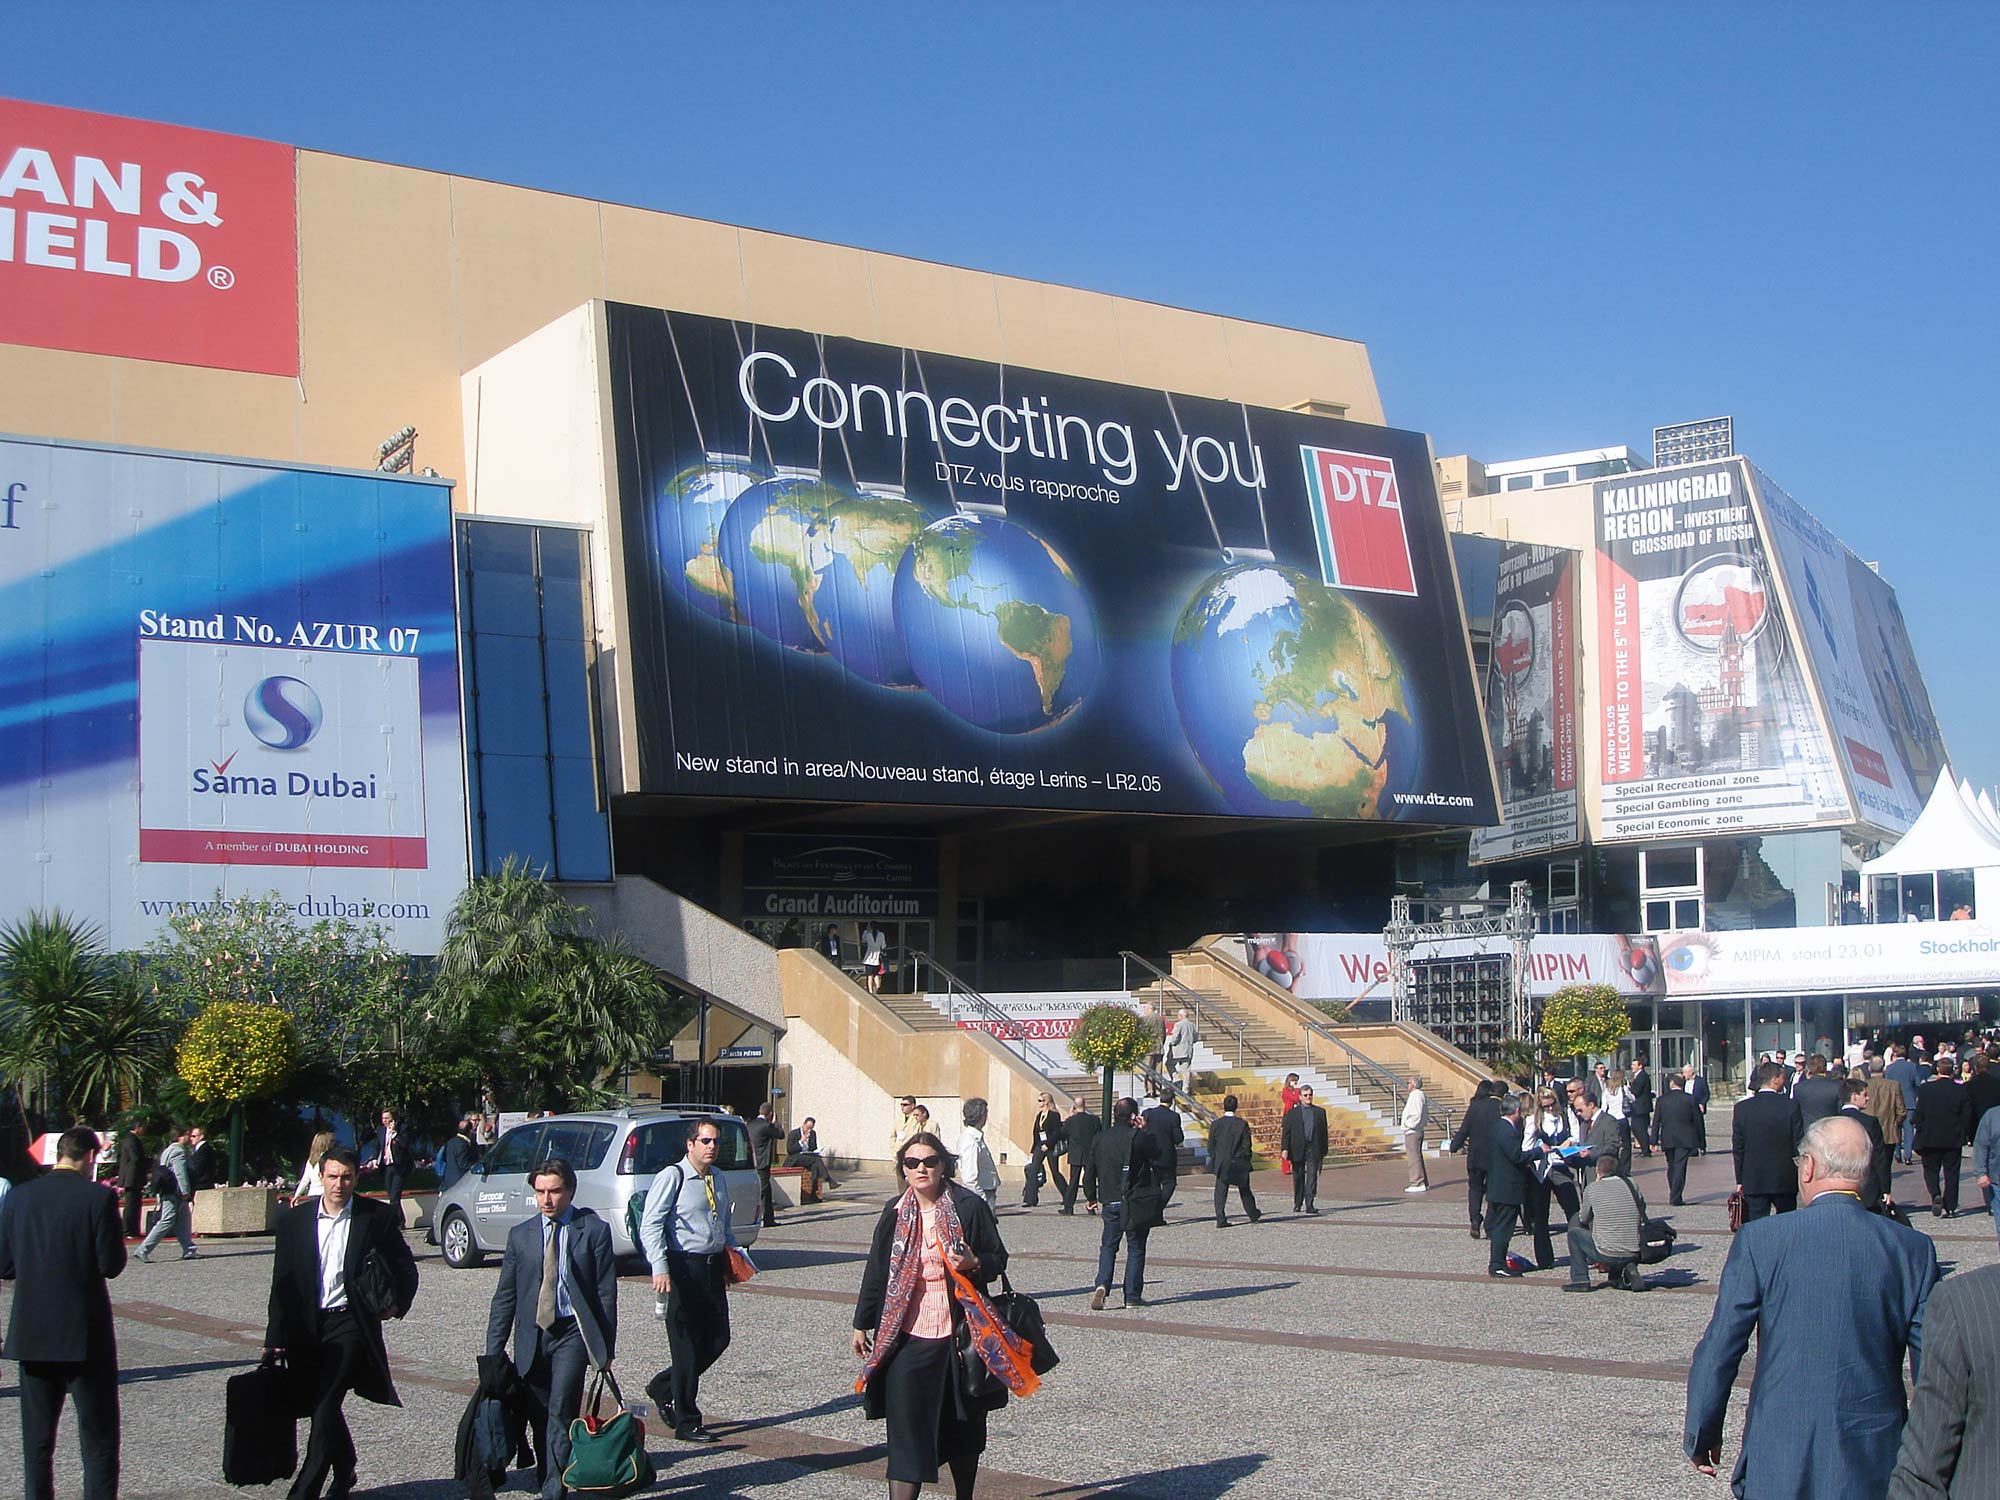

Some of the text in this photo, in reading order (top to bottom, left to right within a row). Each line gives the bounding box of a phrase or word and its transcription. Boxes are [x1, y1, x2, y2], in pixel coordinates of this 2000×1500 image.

[160, 171, 224, 227] &
[738, 351, 1267, 491] Connecting you
[935, 461, 1120, 504] DTZ vous rapproche
[1327, 462, 1399, 510] DTZ
[1602, 471, 1732, 515] KALININGRAD
[1604, 507, 1674, 542] REGION
[1684, 505, 1748, 529] INVESTMENT
[1632, 523, 1755, 556] CROSSROAD OF RUSSIA
[1614, 583, 1627, 626] LEVEL
[139, 609, 420, 653] Stand No. AZUR 07
[1616, 649, 1628, 678] THE
[1617, 681, 1630, 700] TO
[1606, 705, 1616, 775] STAND M5.05
[1617, 703, 1631, 774] WELCOME
[193, 768, 376, 799] Sama Dubai
[675, 752, 719, 773] New
[725, 756, 778, 776] stand
[784, 757, 800, 776] in
[805, 760, 927, 782] area/Nouveau
[932, 766, 984, 786] stand,
[990, 767, 1035, 790] étage
[1040, 769, 1087, 790] Lerins
[1106, 772, 1161, 792] LR2.05
[1615, 775, 1760, 797] Special Recreational zone
[1393, 792, 1474, 807] www.dtz.com
[1615, 794, 1743, 815] Special Gambling zone
[1616, 814, 1743, 834] Special Economic zone
[205, 841, 369, 854] A member of DUBAI HOLDING
[765, 893, 920, 914] Grand Auditorium
[1792, 945, 1831, 961] stand
[1838, 943, 1883, 959] 23.01
